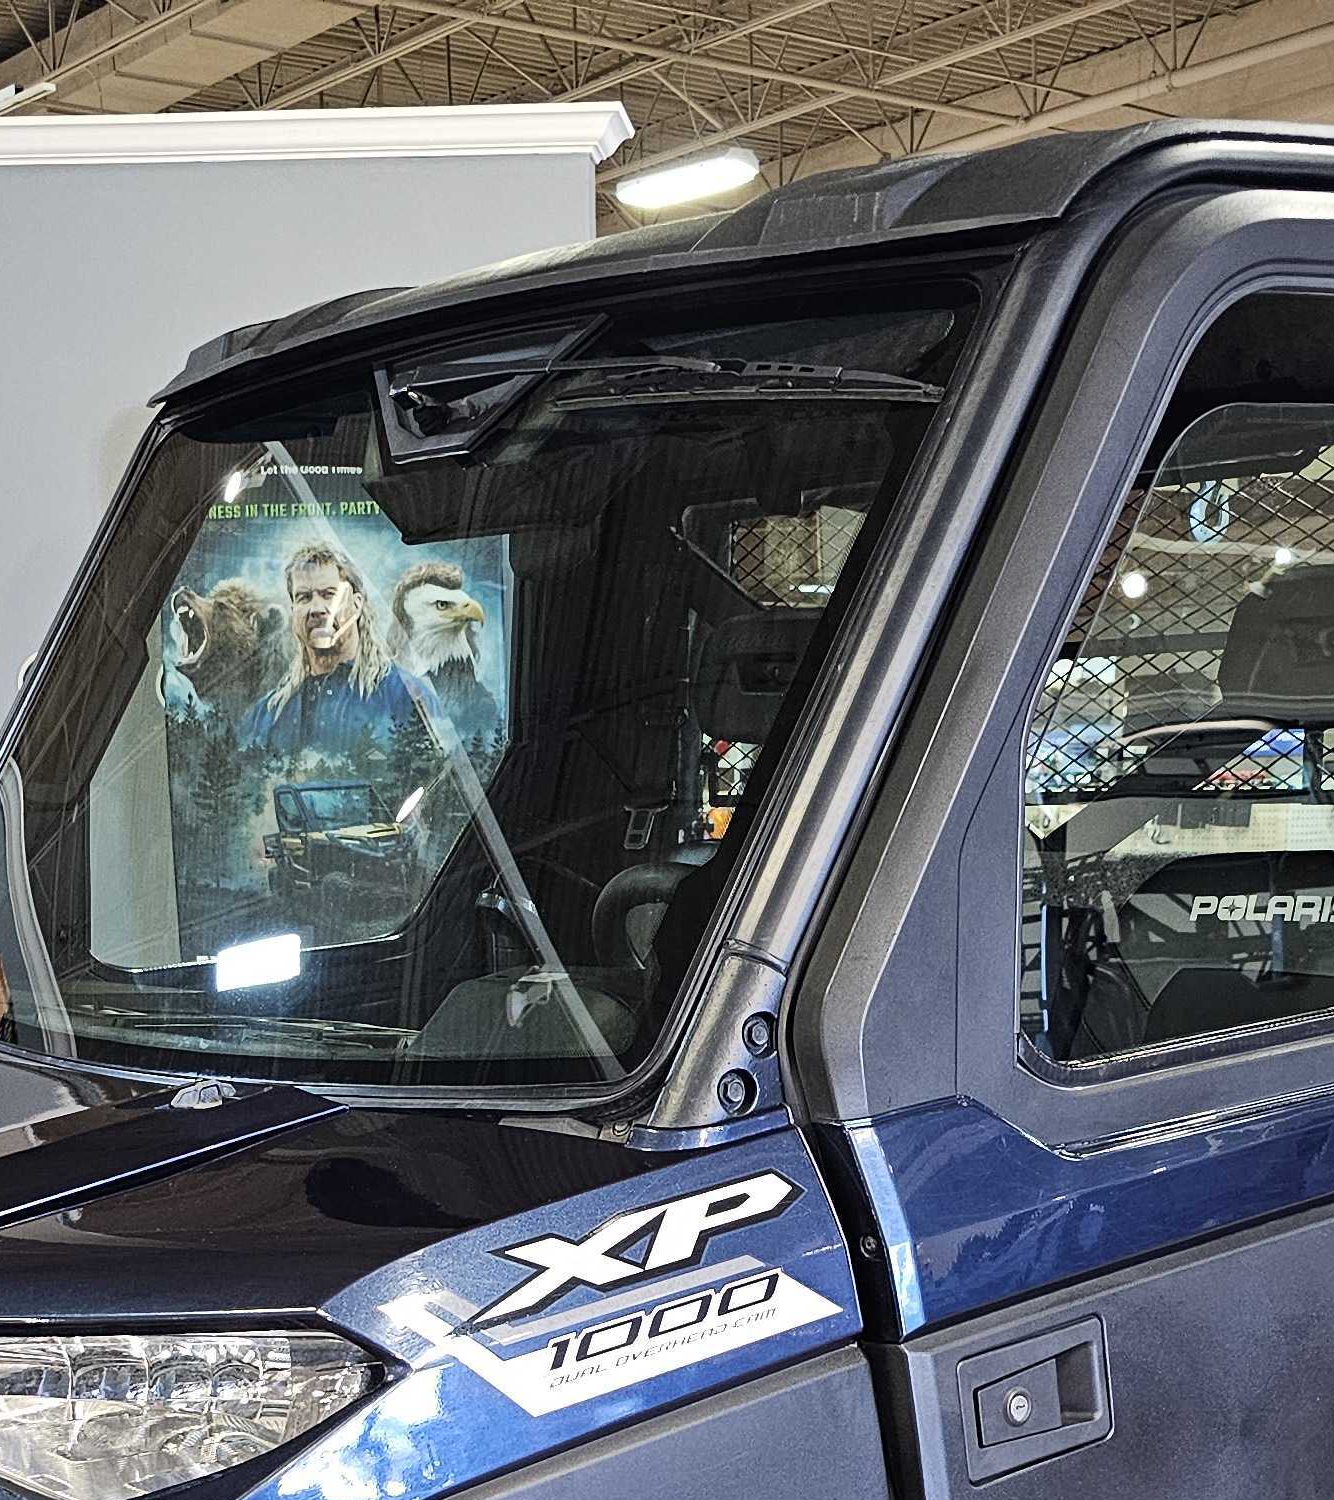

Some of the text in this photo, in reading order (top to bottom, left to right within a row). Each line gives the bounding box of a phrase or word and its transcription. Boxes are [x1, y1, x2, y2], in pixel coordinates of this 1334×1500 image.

[207, 504, 241, 519] NESS
[245, 503, 258, 518] IN
[262, 503, 287, 517] THE
[291, 502, 336, 517] FRONT.
[468, 1168, 806, 1328] XP
[549, 1272, 780, 1372] 1000
[549, 1305, 779, 1388] DUAL OVERHEAD CAM
